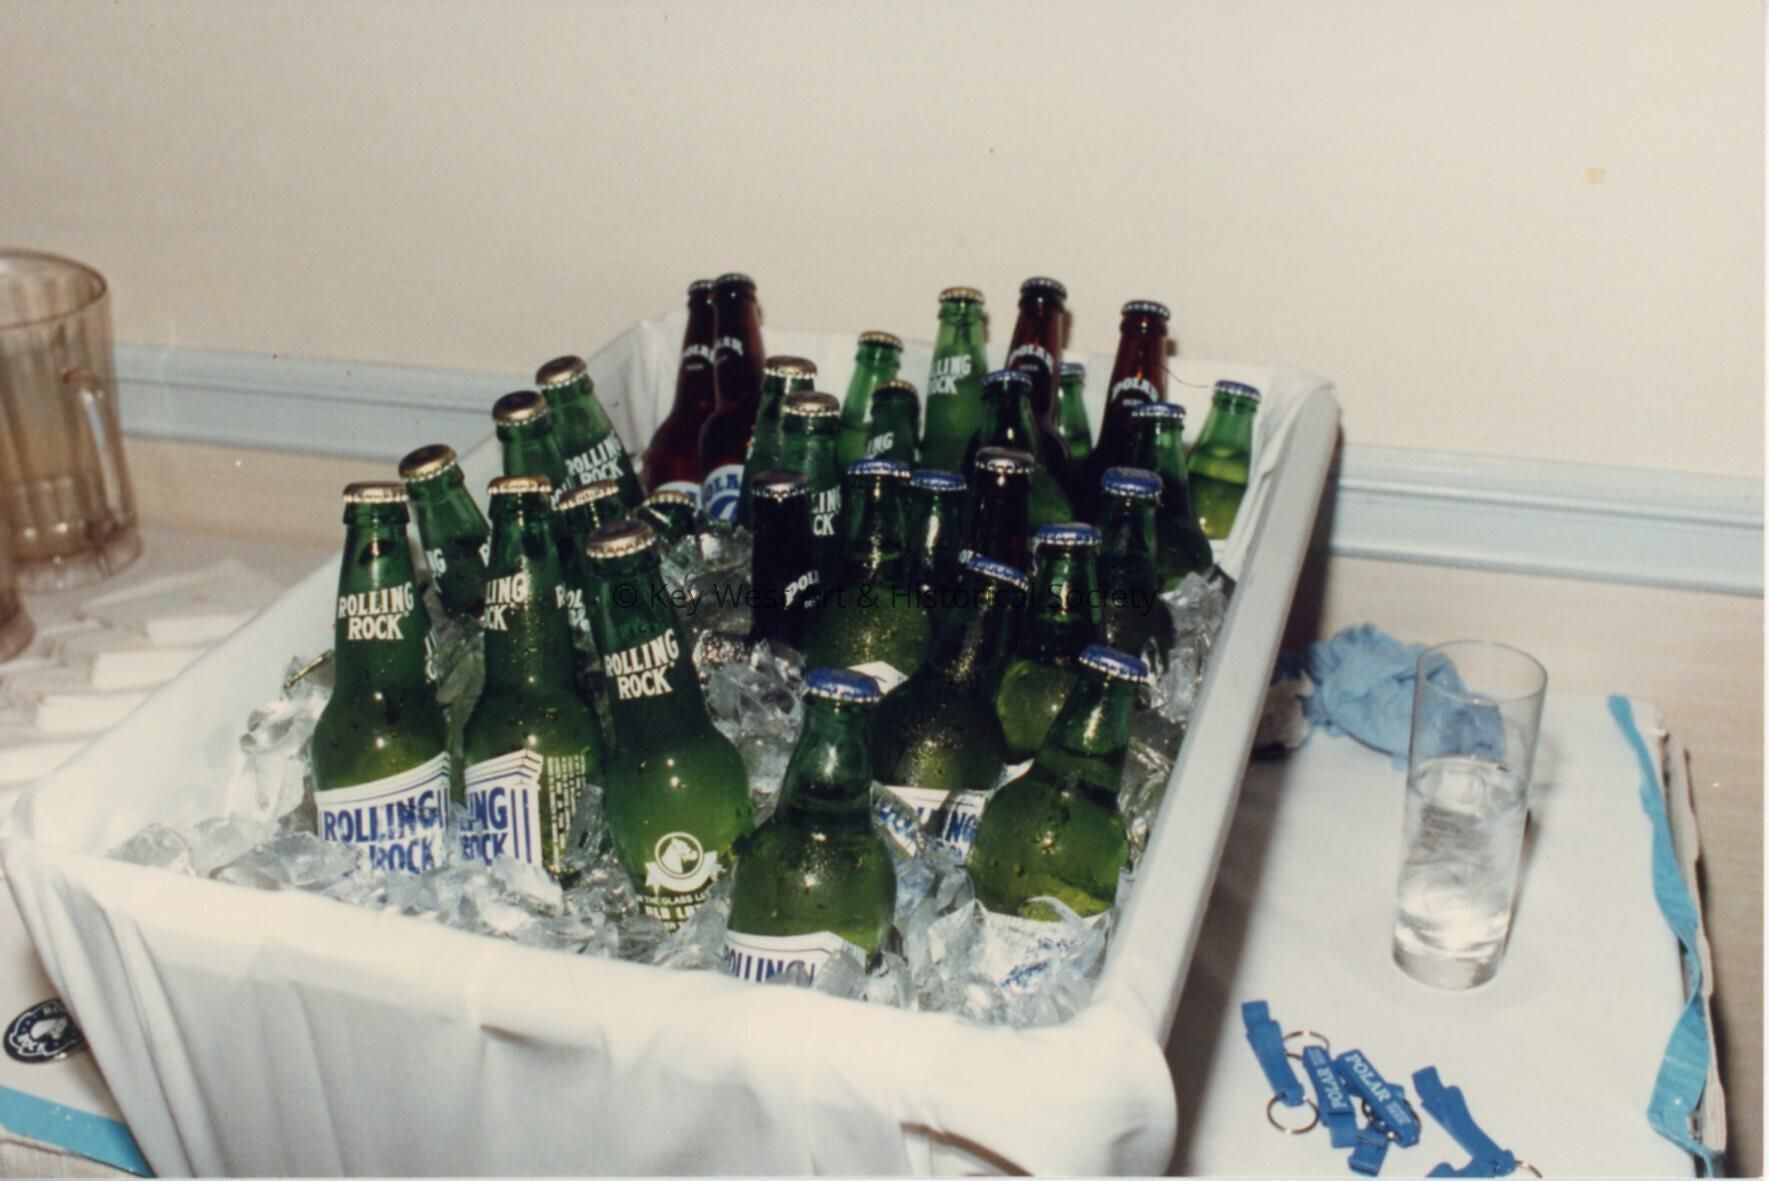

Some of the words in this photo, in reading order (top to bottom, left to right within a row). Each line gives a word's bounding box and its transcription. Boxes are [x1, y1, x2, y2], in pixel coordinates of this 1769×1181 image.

[337, 581, 415, 618] ROLLING
[347, 614, 404, 640] ROCK
[604, 628, 680, 677] ROLLING
[617, 665, 674, 700] ROCK
[323, 789, 438, 843] ROLLING
[1316, 1066, 1349, 1109] POLAR
[1344, 1052, 1391, 1102] POLAR
